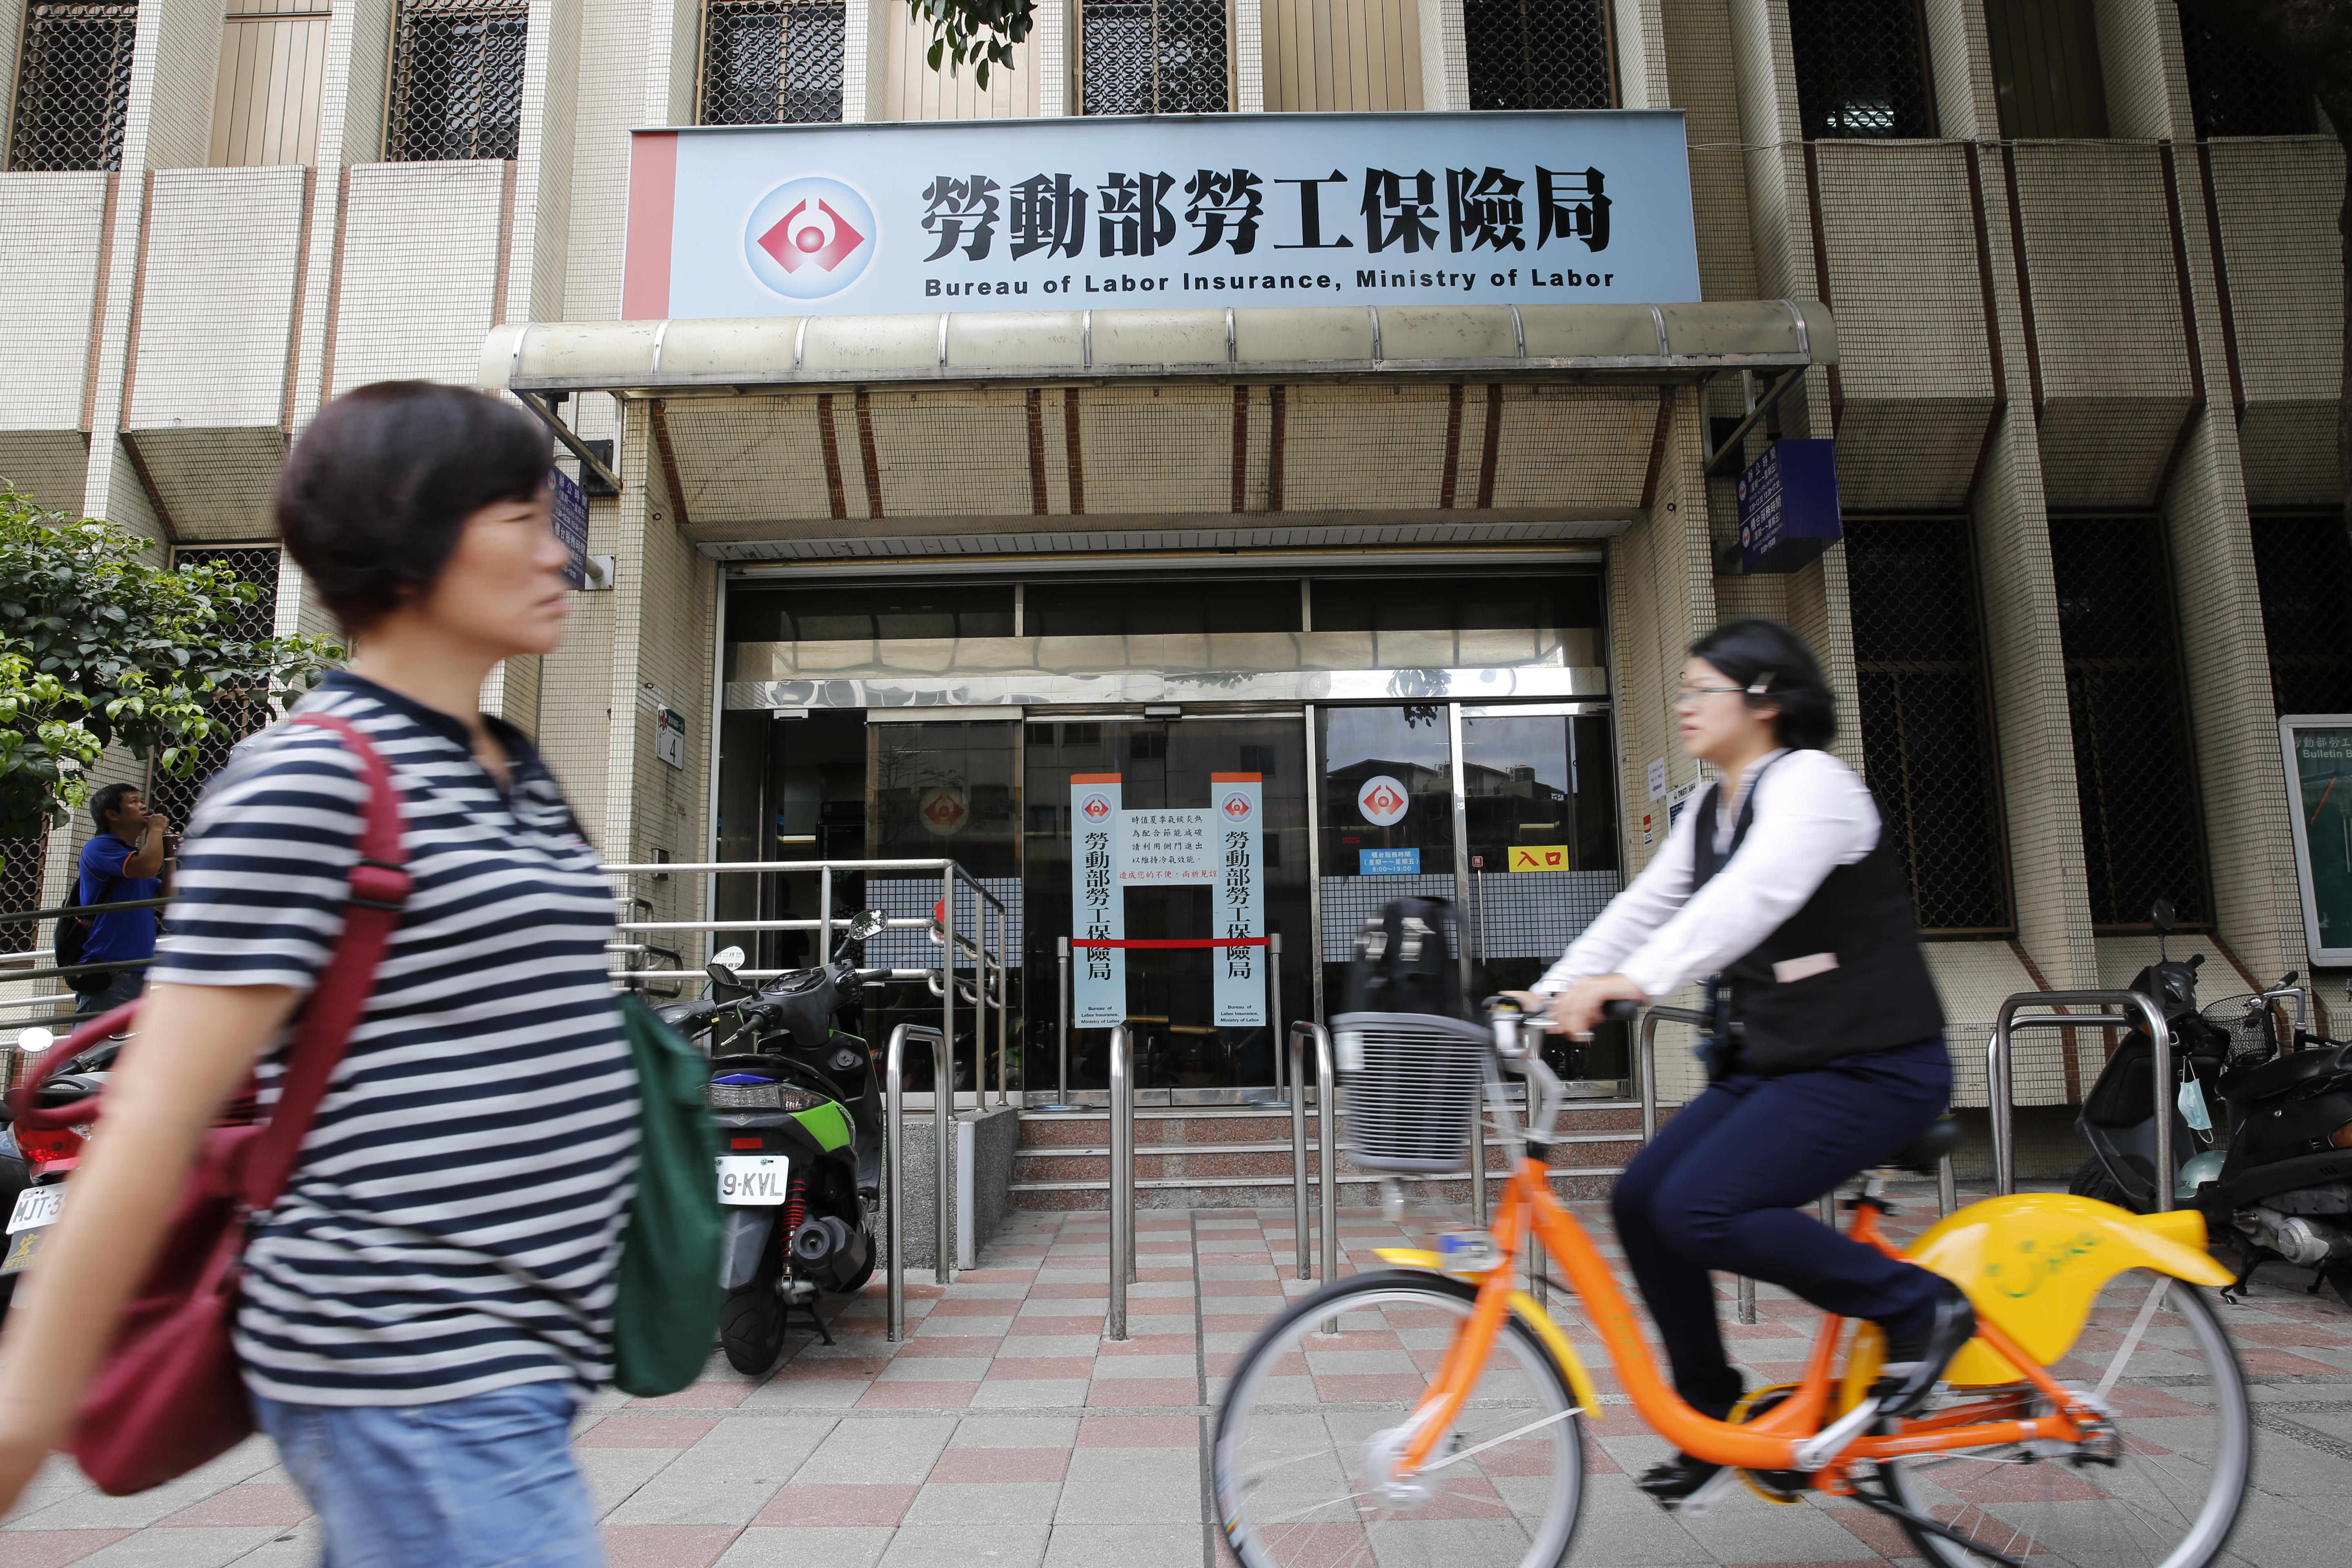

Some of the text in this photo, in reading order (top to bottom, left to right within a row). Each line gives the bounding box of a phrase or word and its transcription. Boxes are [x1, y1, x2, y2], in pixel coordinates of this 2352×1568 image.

[921, 165, 1613, 262] 勞動部勞工保險局
[926, 269, 1614, 296] Bureau of Labor Insurance, Ministry of Labor
[1748, 446, 1776, 483] 辦公時間
[559, 474, 588, 509] 辦公時間
[1751, 494, 1782, 532] 櫃台服務時間
[555, 521, 586, 556] 櫃台服務時間
[670, 739, 676, 763] 4
[2294, 736, 2352, 748] 勞動部勞工
[2303, 749, 2343, 758] Bulletin
[1131, 815, 1203, 824] 時值夏季氣候炎熱
[1132, 829, 1203, 837] 為配合節能減碳
[1131, 842, 1203, 851] 請利用側門進出
[1517, 851, 1562, 867] 入口
[1132, 855, 1201, 864] 以維持冷氣效能。
[1085, 832, 1111, 980] 勞動部勞工保險局
[1225, 831, 1252, 979] 勞動部勞工保險局
[715, 1173, 783, 1196] 9-KVL
[12, 1192, 68, 1223] MJT-3
